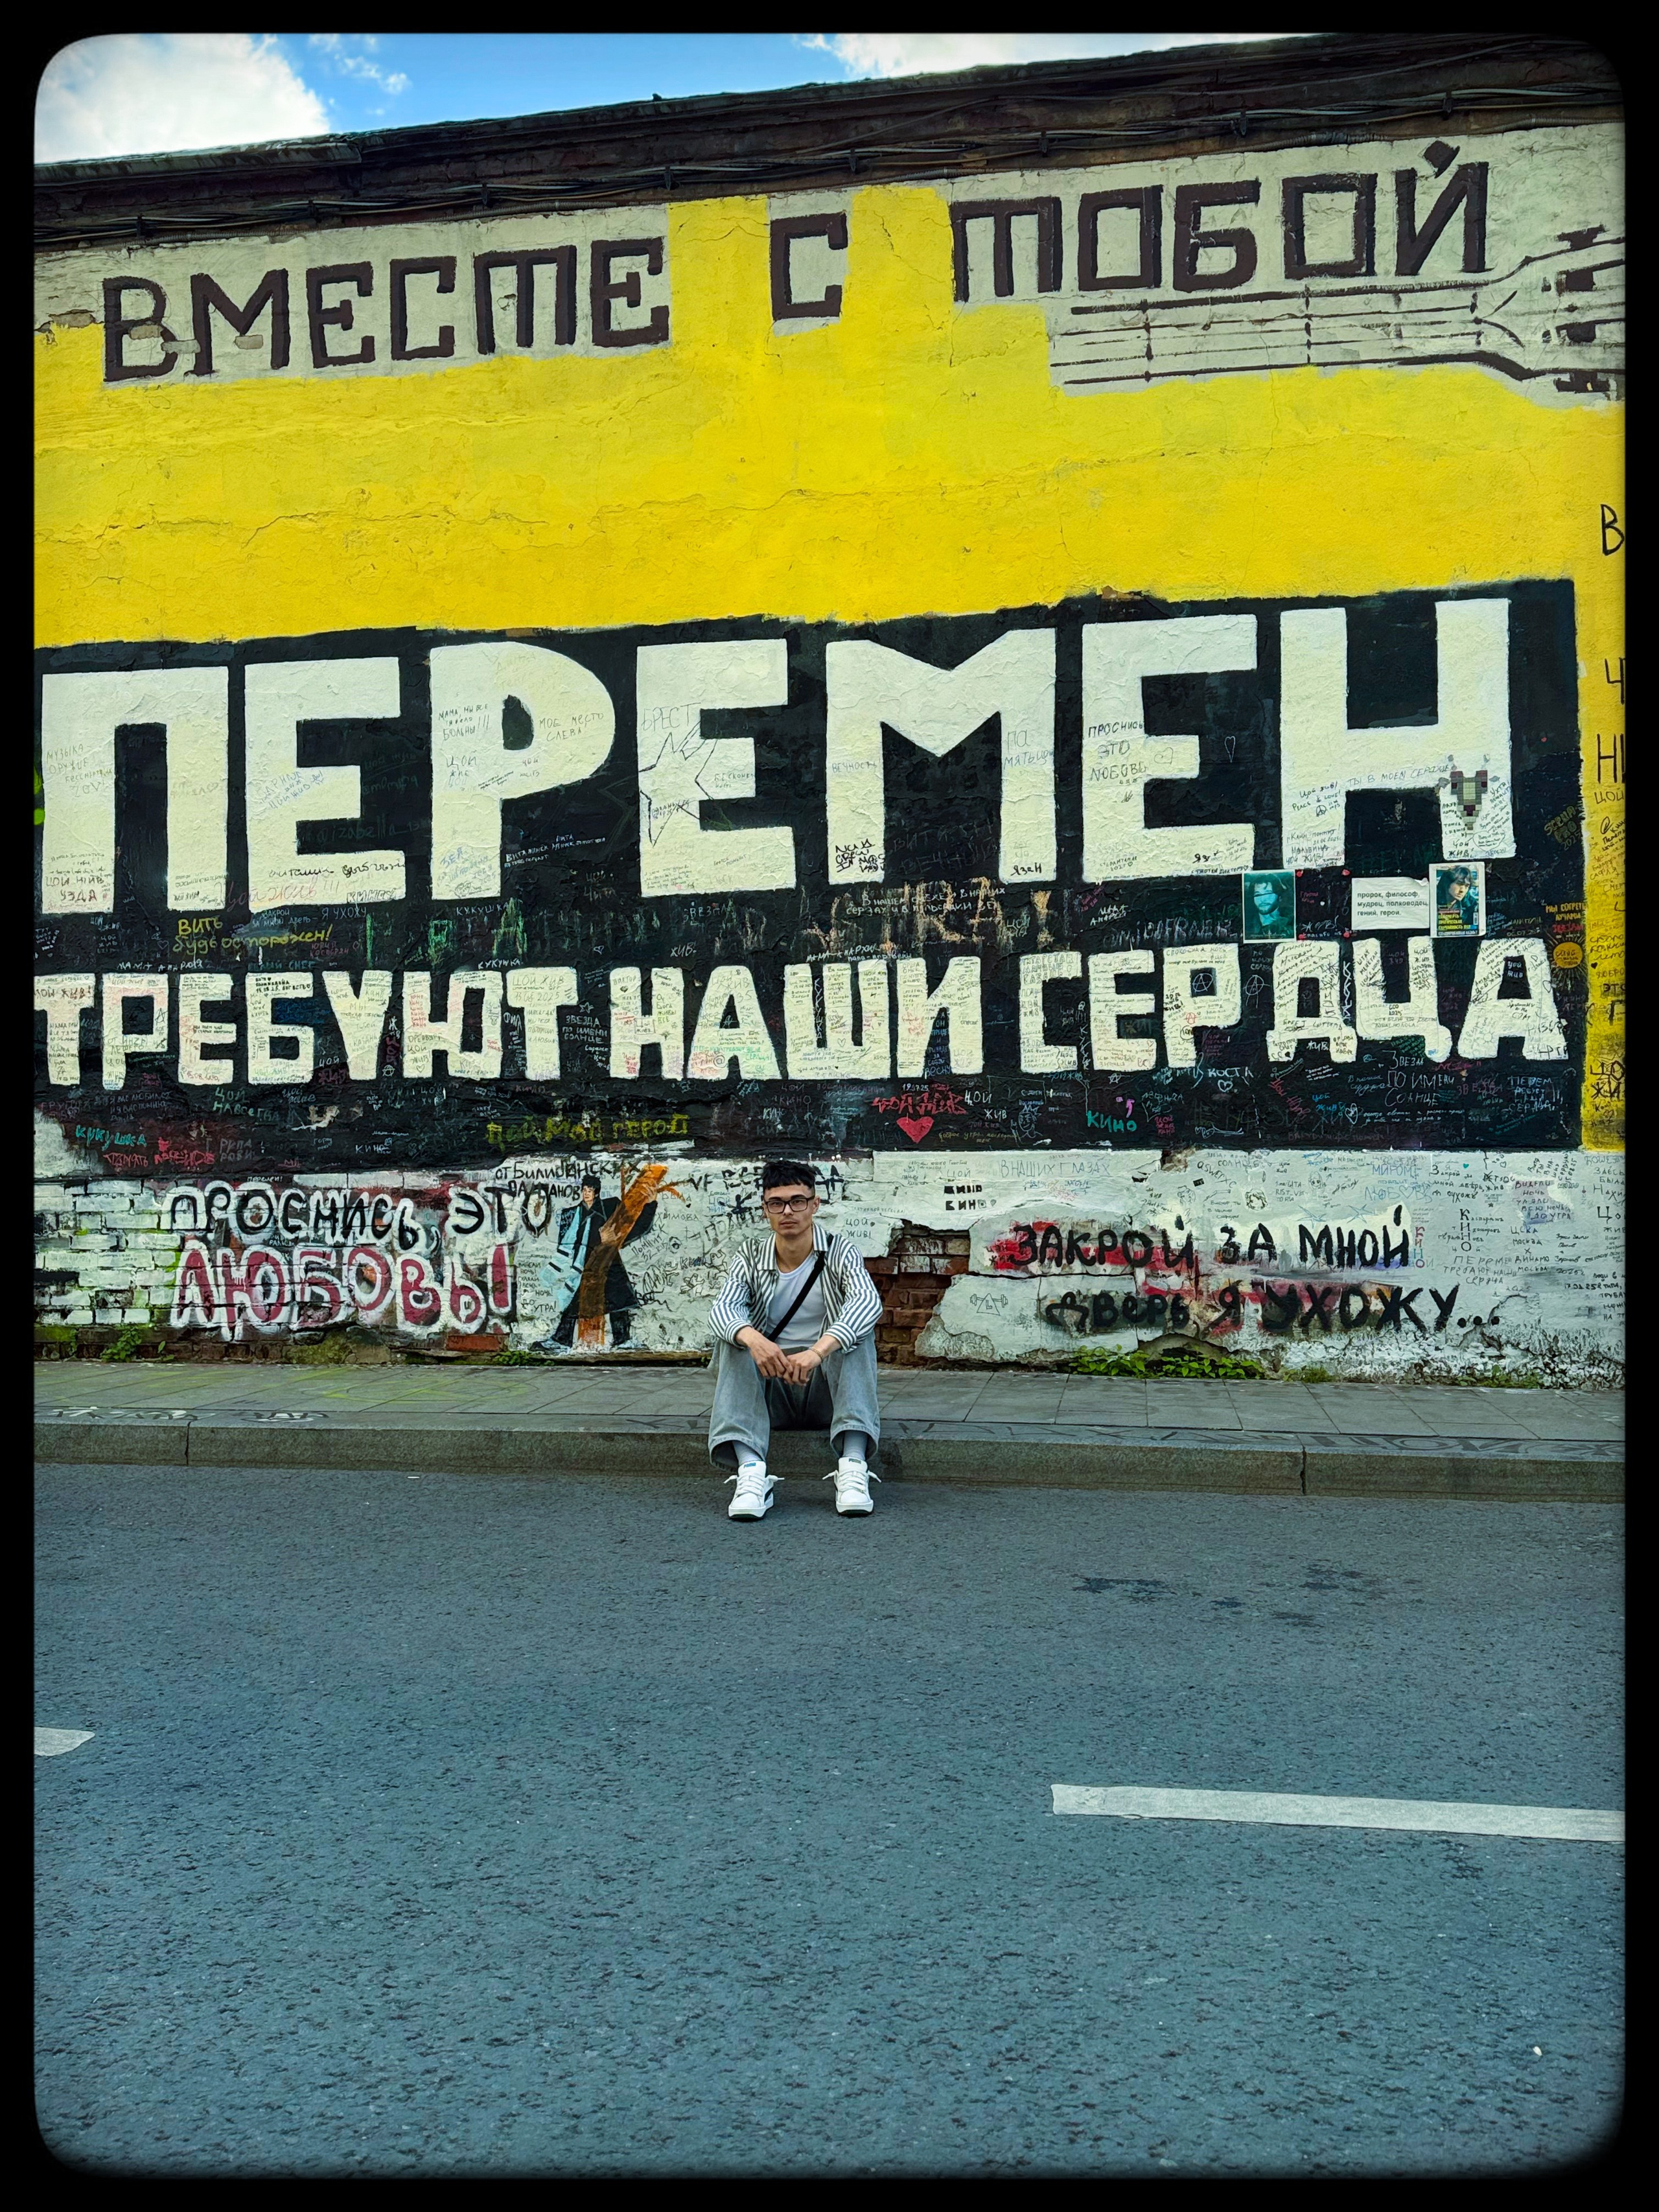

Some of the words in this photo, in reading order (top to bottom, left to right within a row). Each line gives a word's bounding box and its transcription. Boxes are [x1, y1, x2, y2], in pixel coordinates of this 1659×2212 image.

[770, 213, 847, 320] С
[1601, 504, 1625, 556] В
[642, 702, 701, 731] БРЕСТ
[1088, 721, 1144, 738] ПРОСНИСЬ
[41, 598, 1518, 915] ПЕРЕМЕН
[1357, 891, 1384, 899] пророк,
[1385, 891, 1421, 900] философ,
[32, 967, 579, 1091] ТРЕБУЮТ
[609, 955, 984, 1081] НАШИ
[1019, 935, 1569, 1075] СЕРДЦА
[1086, 1110, 1137, 1133] КИНО
[1001, 1159, 1008, 1178] В
[1011, 1160, 1055, 1178] НАШИХ
[1060, 1160, 1111, 1177] ГЛАЗАХ
[845, 1218, 869, 1228] ЦОЙ
[1011, 1213, 1197, 1269] ЗАКРОЙ
[1220, 1223, 1277, 1264] ЗА
[1298, 1204, 1410, 1268] МНОЙ
[1511, 1226, 1538, 1236] ЦСКА
[1209, 1281, 1246, 1327] Я
